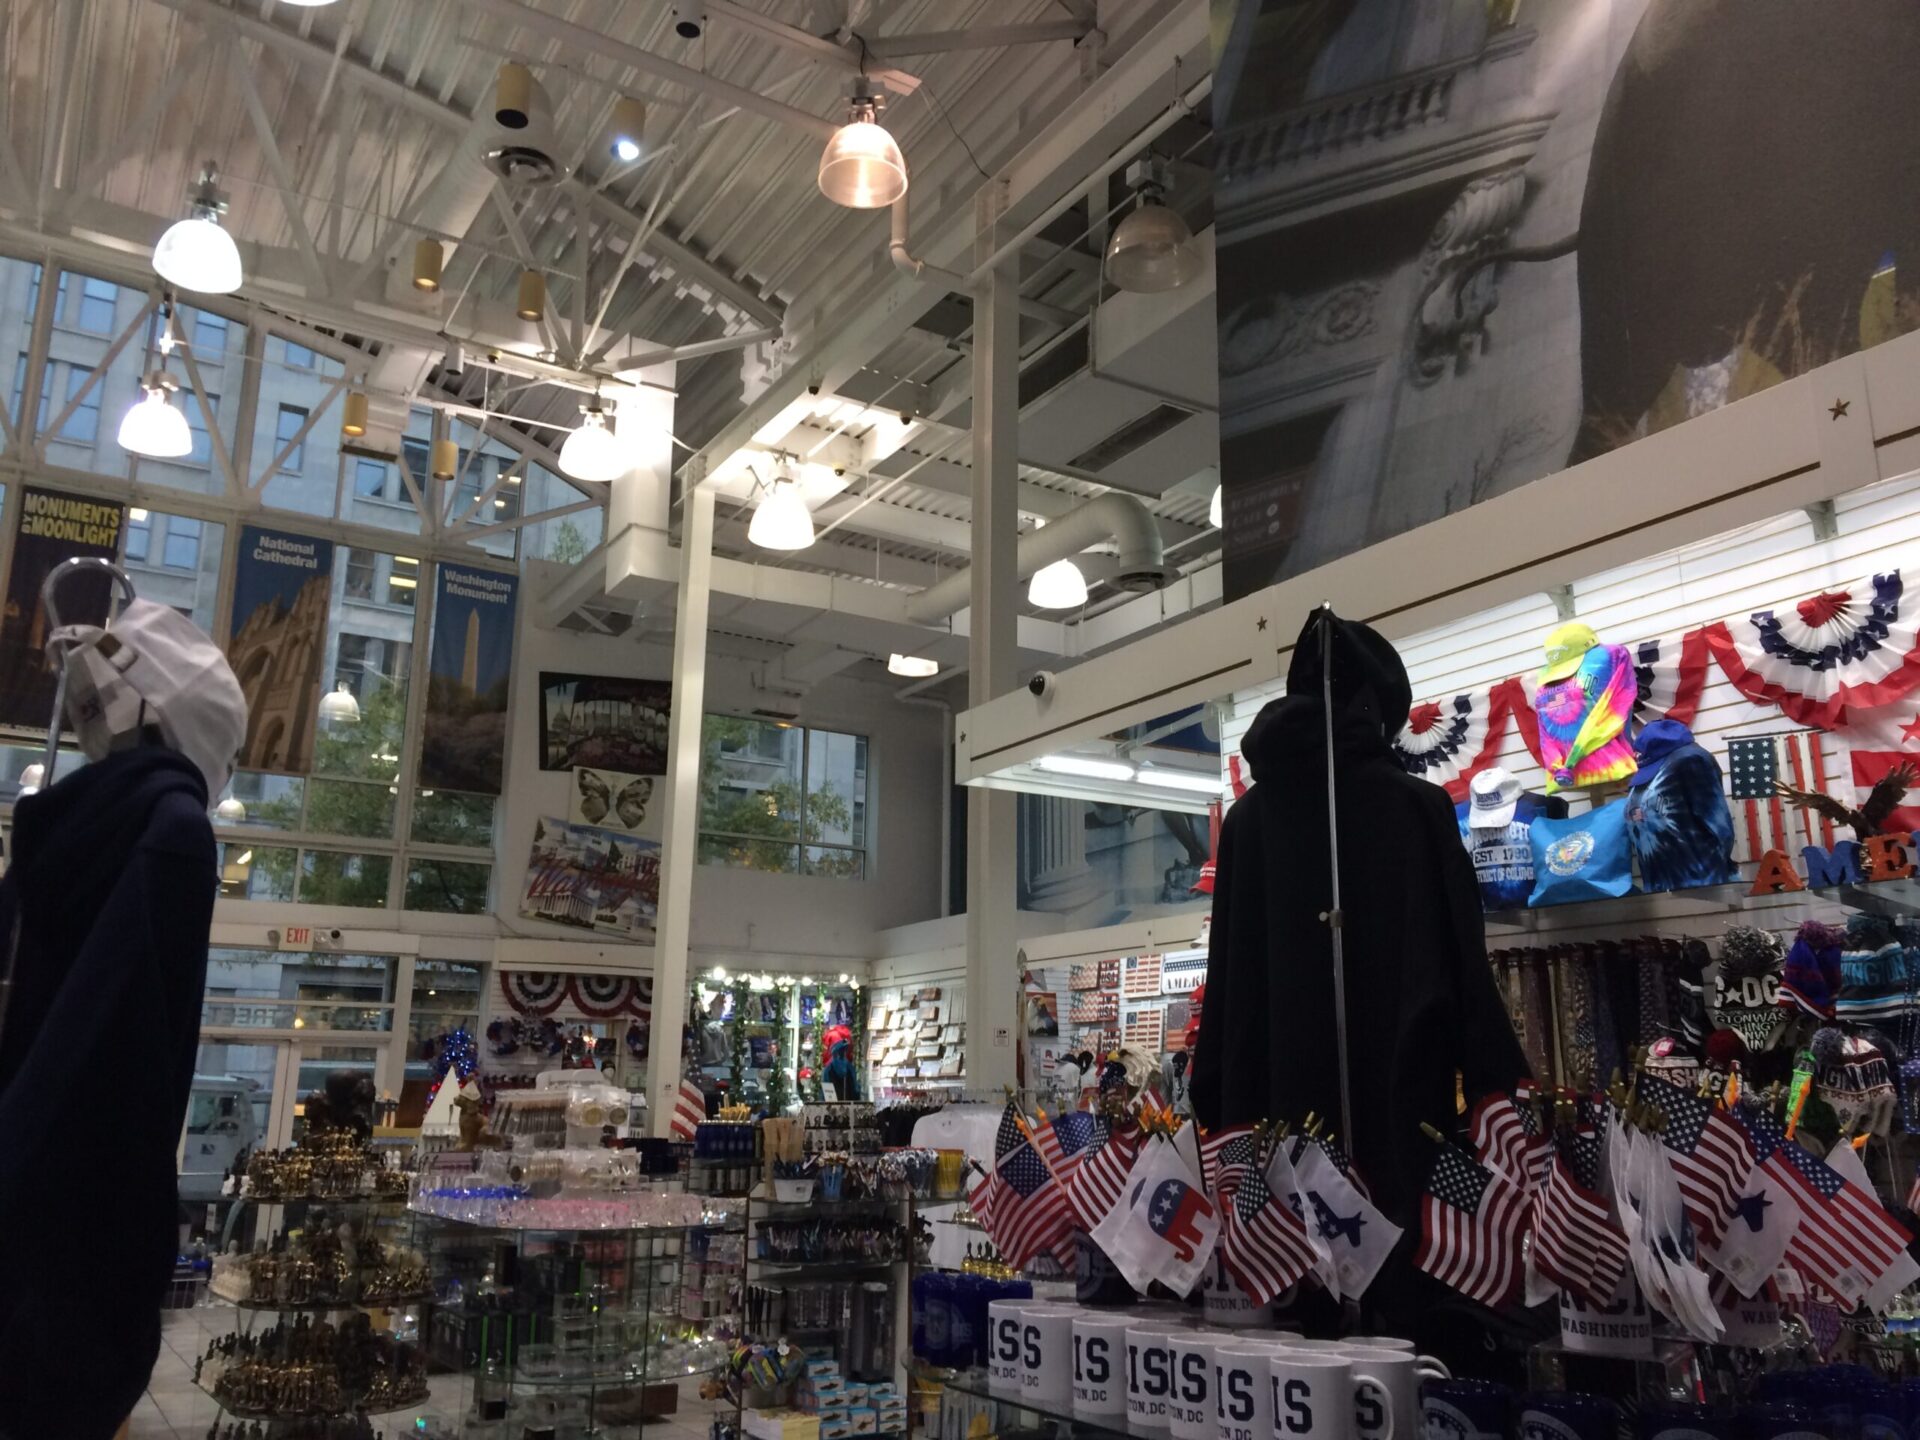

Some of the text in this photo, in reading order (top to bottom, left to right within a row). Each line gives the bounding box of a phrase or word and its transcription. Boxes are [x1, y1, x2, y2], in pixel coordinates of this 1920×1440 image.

[24, 493, 120, 527] MONUMENTS
[31, 516, 117, 548] MOONLIGHT
[259, 535, 315, 555] National
[253, 548, 317, 569] Cathedral
[444, 569, 511, 592] Washington
[446, 583, 508, 604] Monument
[1474, 849, 1498, 864] EST.
[1750, 829, 1920, 897] AME
[286, 927, 310, 945] EXIT
[1168, 970, 1206, 990] AMERI
